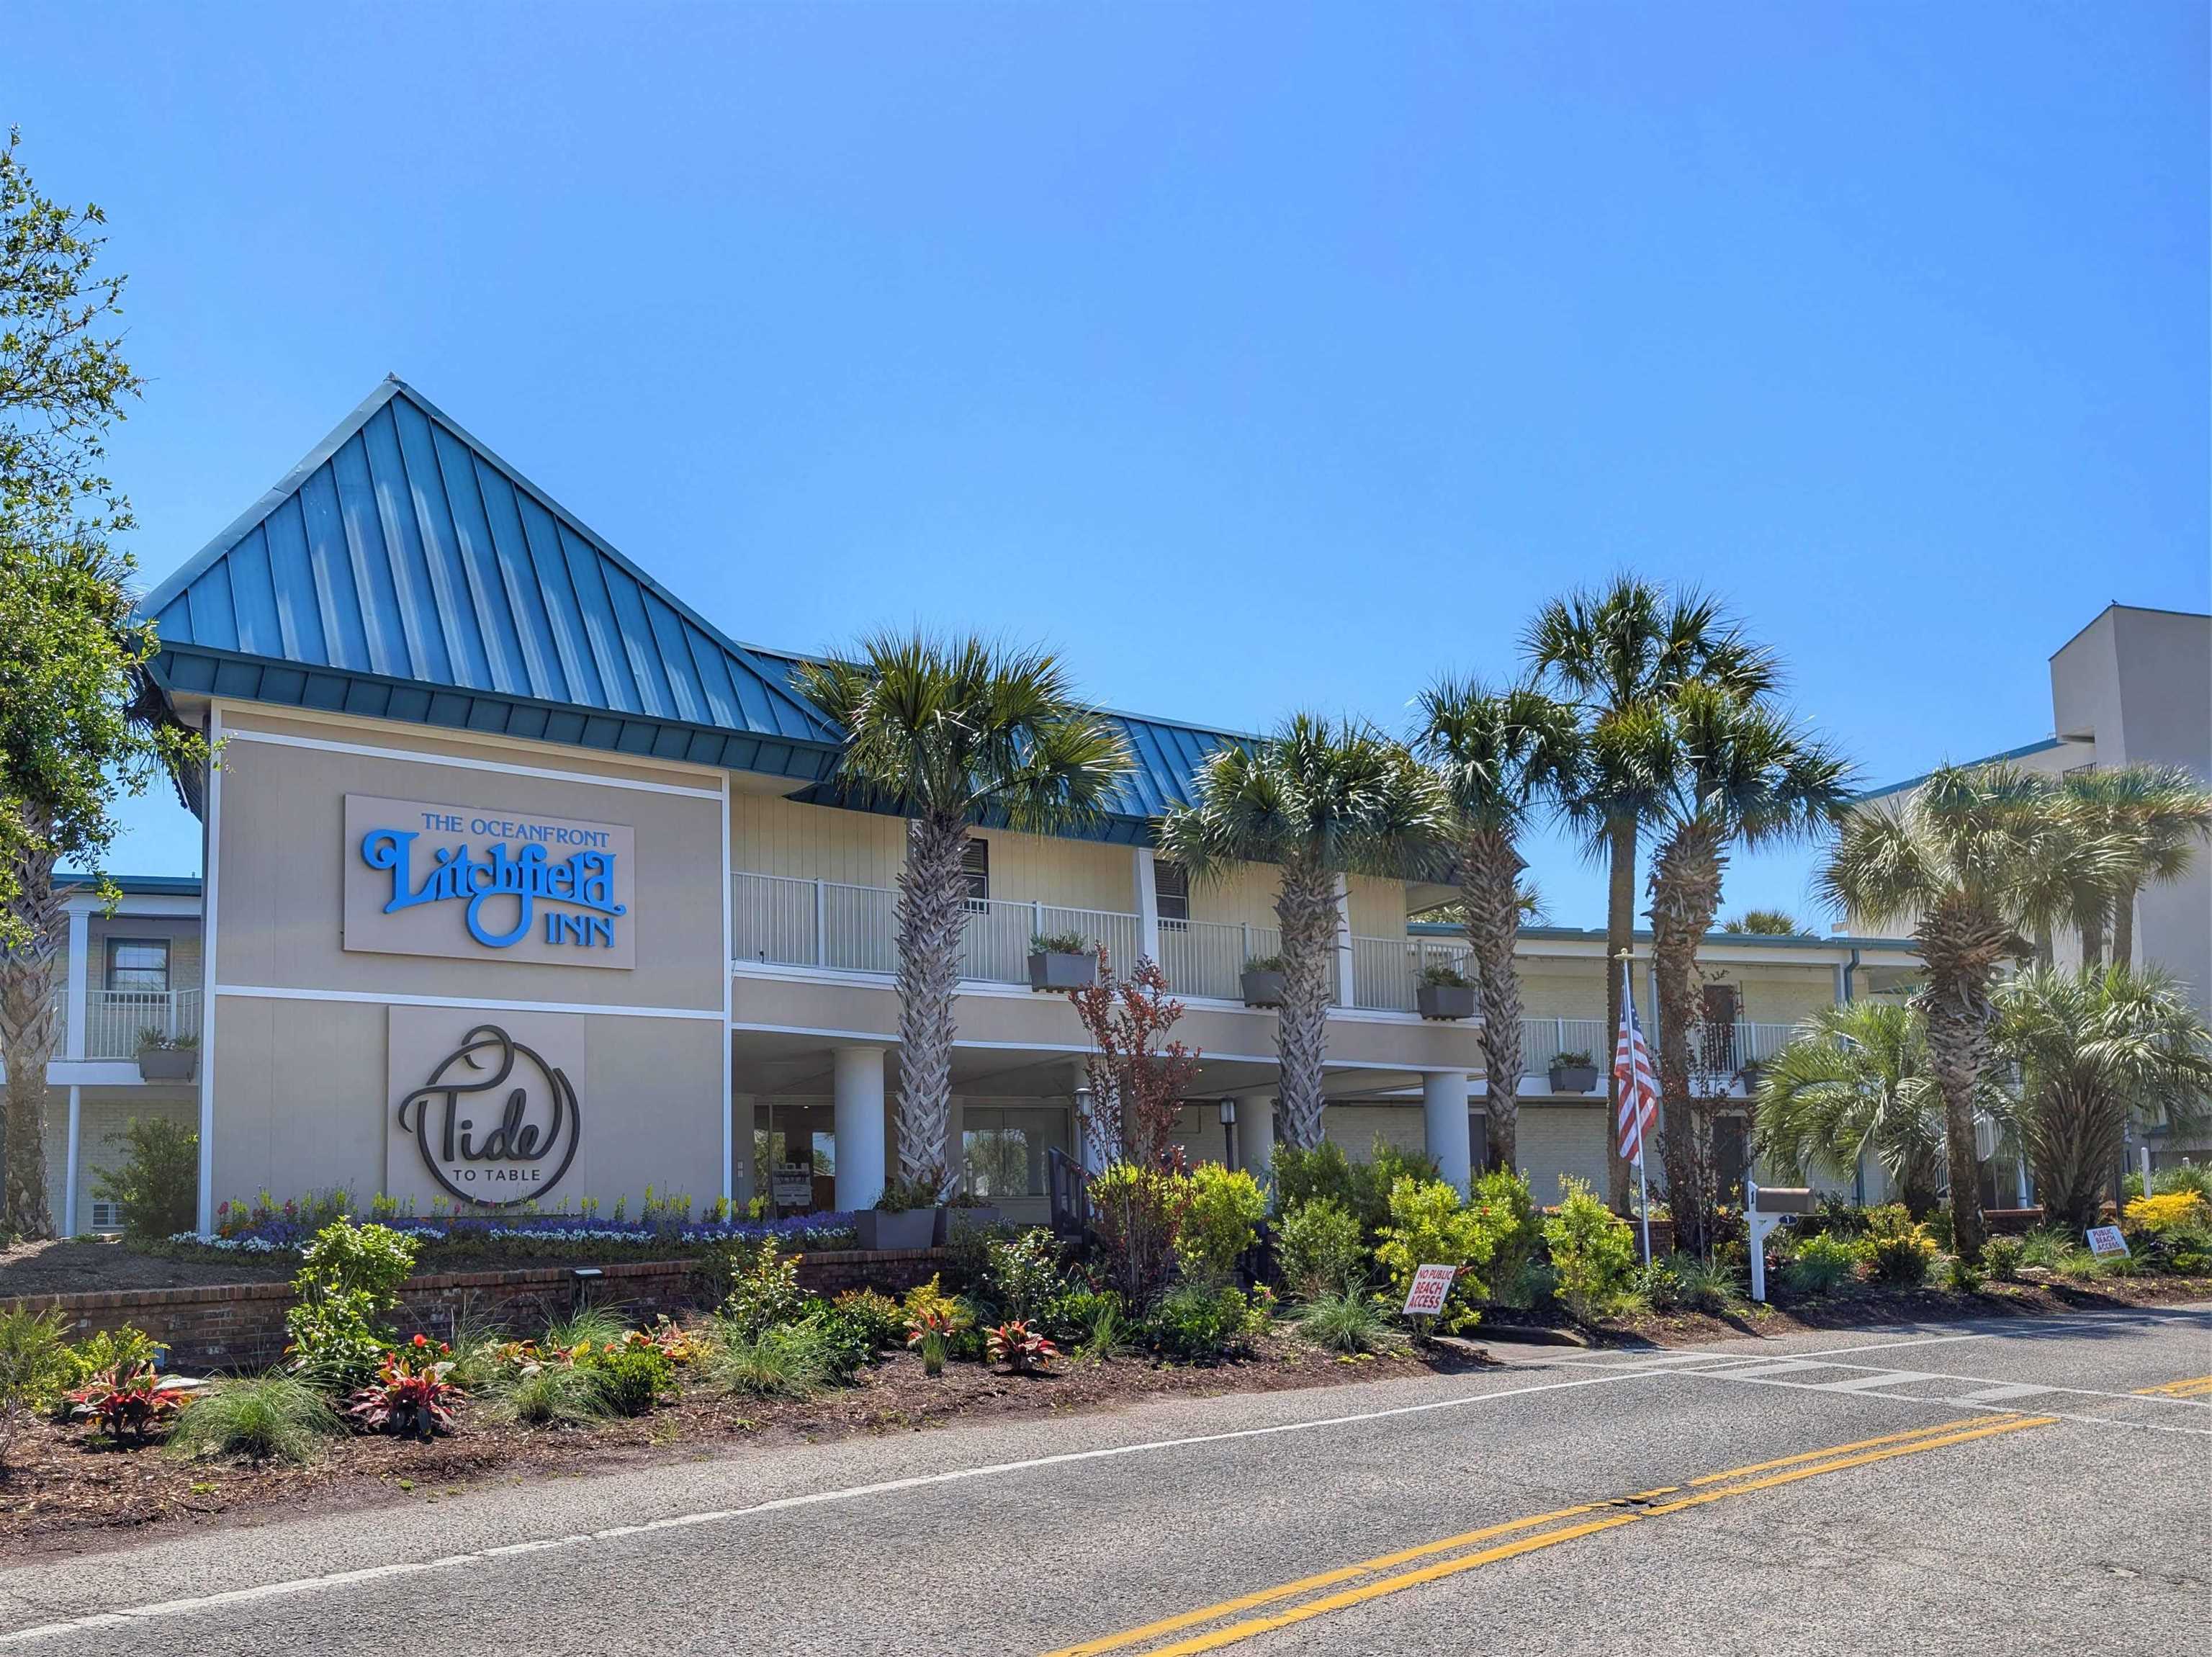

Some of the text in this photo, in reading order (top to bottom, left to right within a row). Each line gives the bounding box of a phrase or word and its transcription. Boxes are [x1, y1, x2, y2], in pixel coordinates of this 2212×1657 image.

[421, 813, 610, 848] THE OCEANFRONT
[361, 829, 626, 948] Litchfield
[545, 912, 615, 948] INN
[398, 1024, 540, 1162] Tide
[453, 1169, 541, 1182] TO TABLE
[2092, 1228, 2113, 1236] PUBLIC
[2096, 1235, 2117, 1244] BEACH
[2098, 1241, 2121, 1251] ACCESS
[1418, 1270, 1452, 1280] NO PUBLIC
[1414, 1282, 1444, 1295] BEACH
[1408, 1295, 1440, 1308] ACCESS
